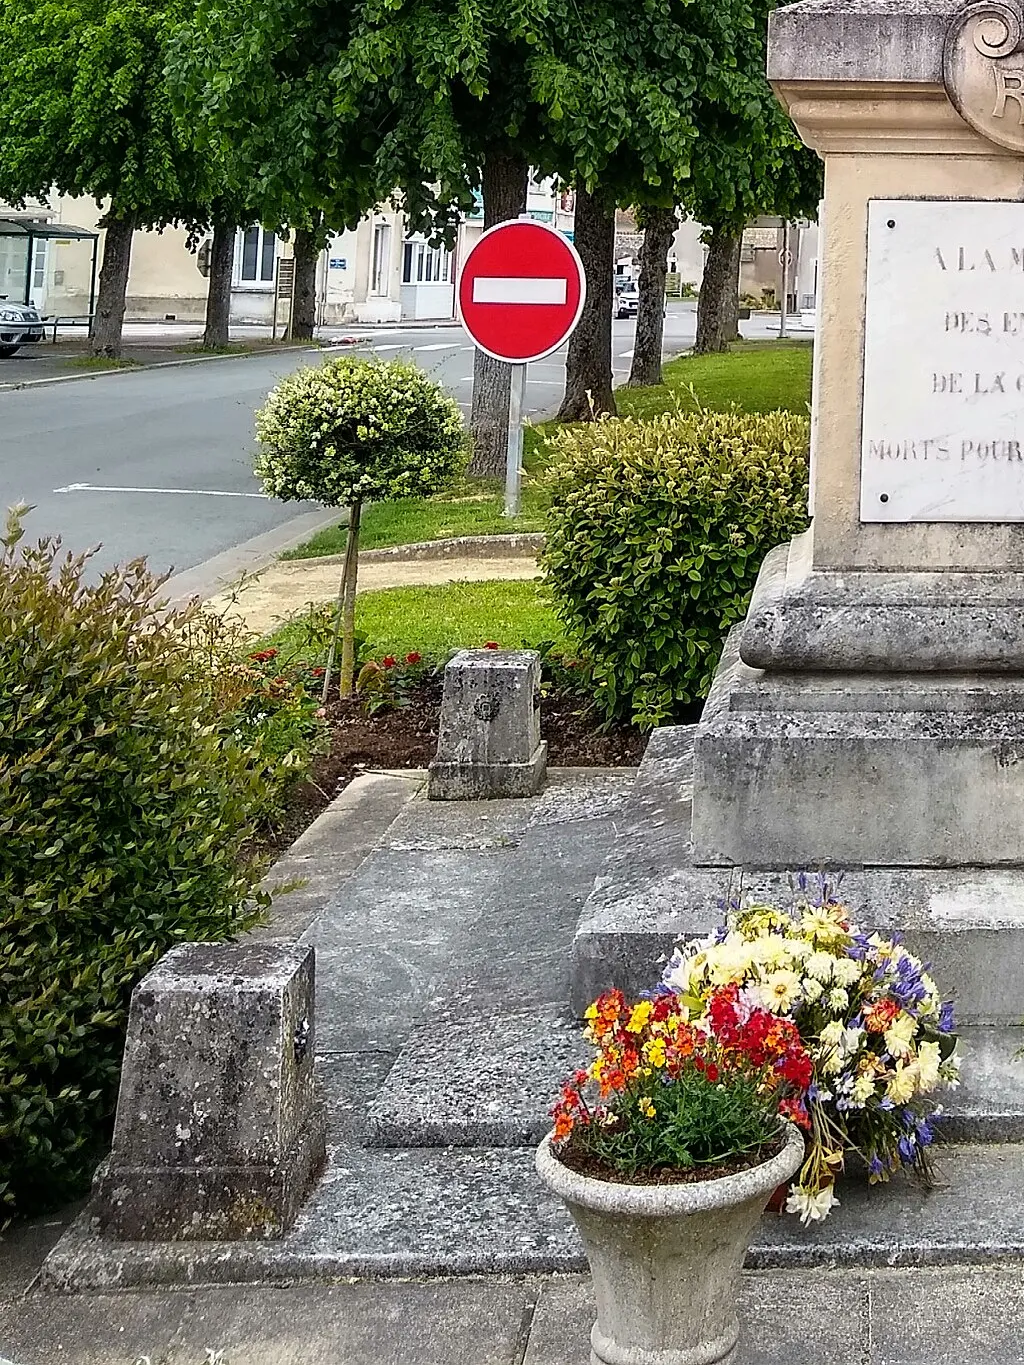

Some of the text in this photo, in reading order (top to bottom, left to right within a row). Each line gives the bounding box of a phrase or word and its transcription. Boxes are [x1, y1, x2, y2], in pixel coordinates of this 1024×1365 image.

[933, 247, 946, 270] A
[958, 247, 996, 272] LA
[945, 311, 992, 335] DES
[932, 372, 962, 394] DE
[974, 371, 1005, 394] LA
[869, 438, 950, 461] MORTS
[961, 439, 1023, 461] POUR
